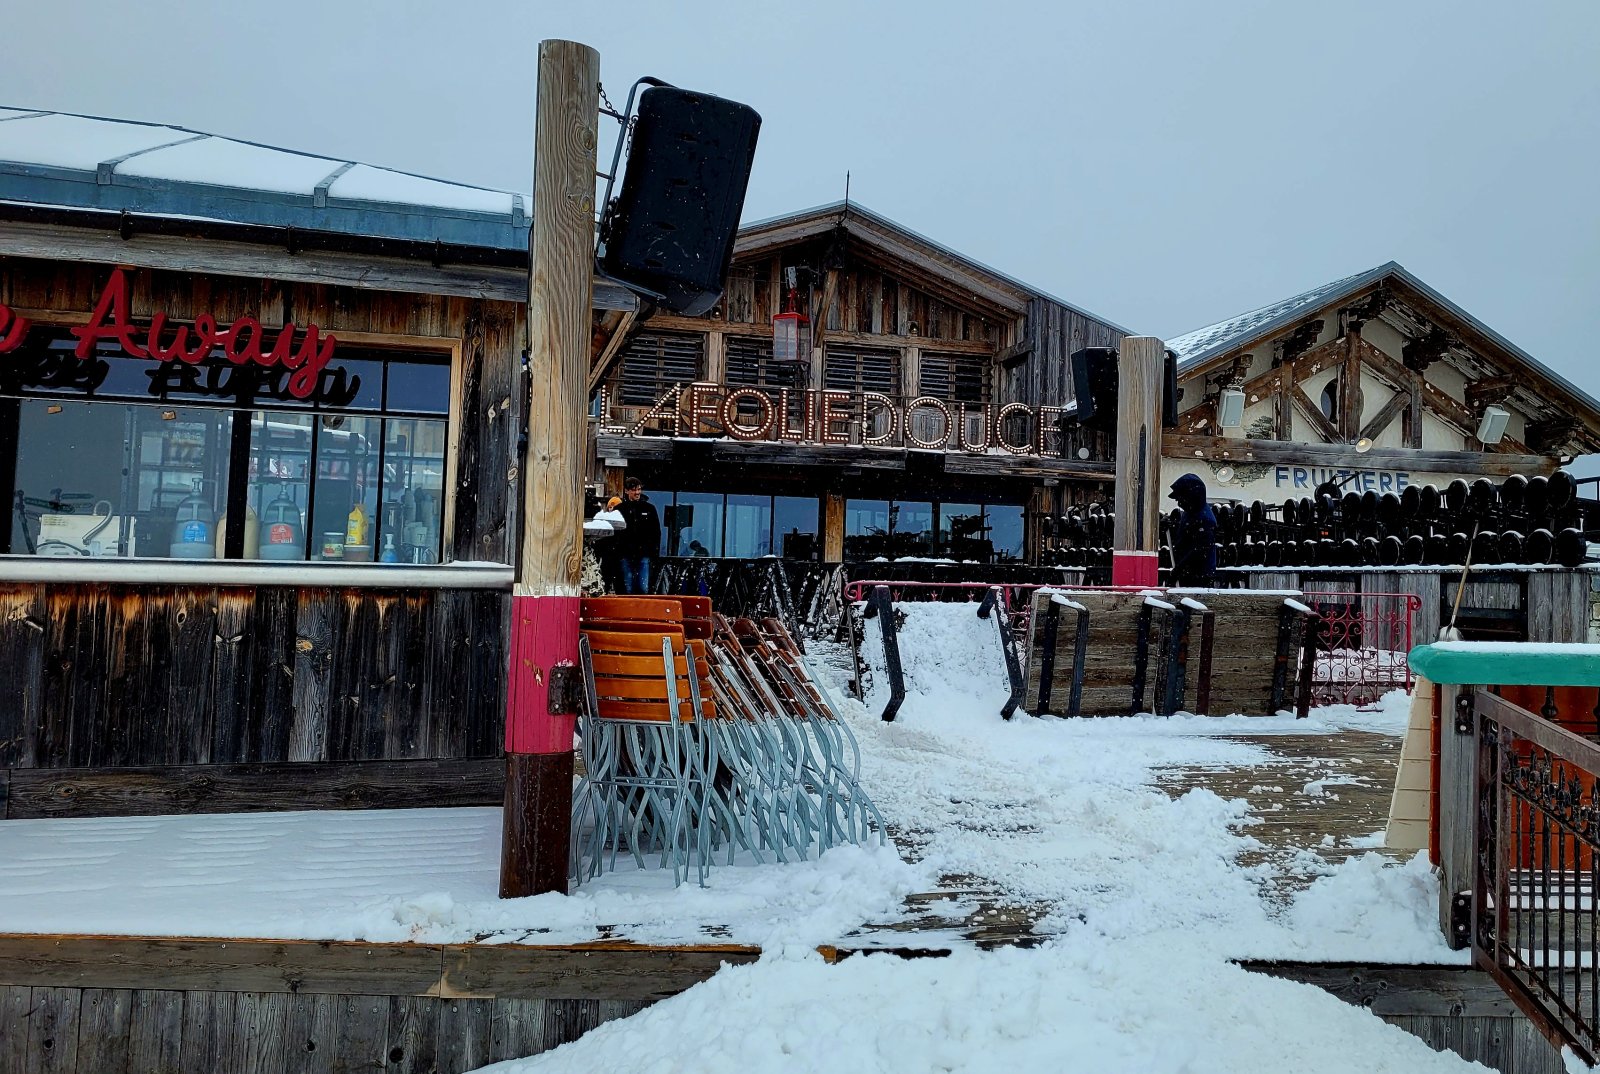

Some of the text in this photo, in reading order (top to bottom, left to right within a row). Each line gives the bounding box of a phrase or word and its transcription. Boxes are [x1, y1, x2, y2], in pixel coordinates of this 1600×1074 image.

[70, 269, 336, 398] Away
[690, 382, 850, 443] FOLIE
[861, 392, 1063, 457] DOUCE
